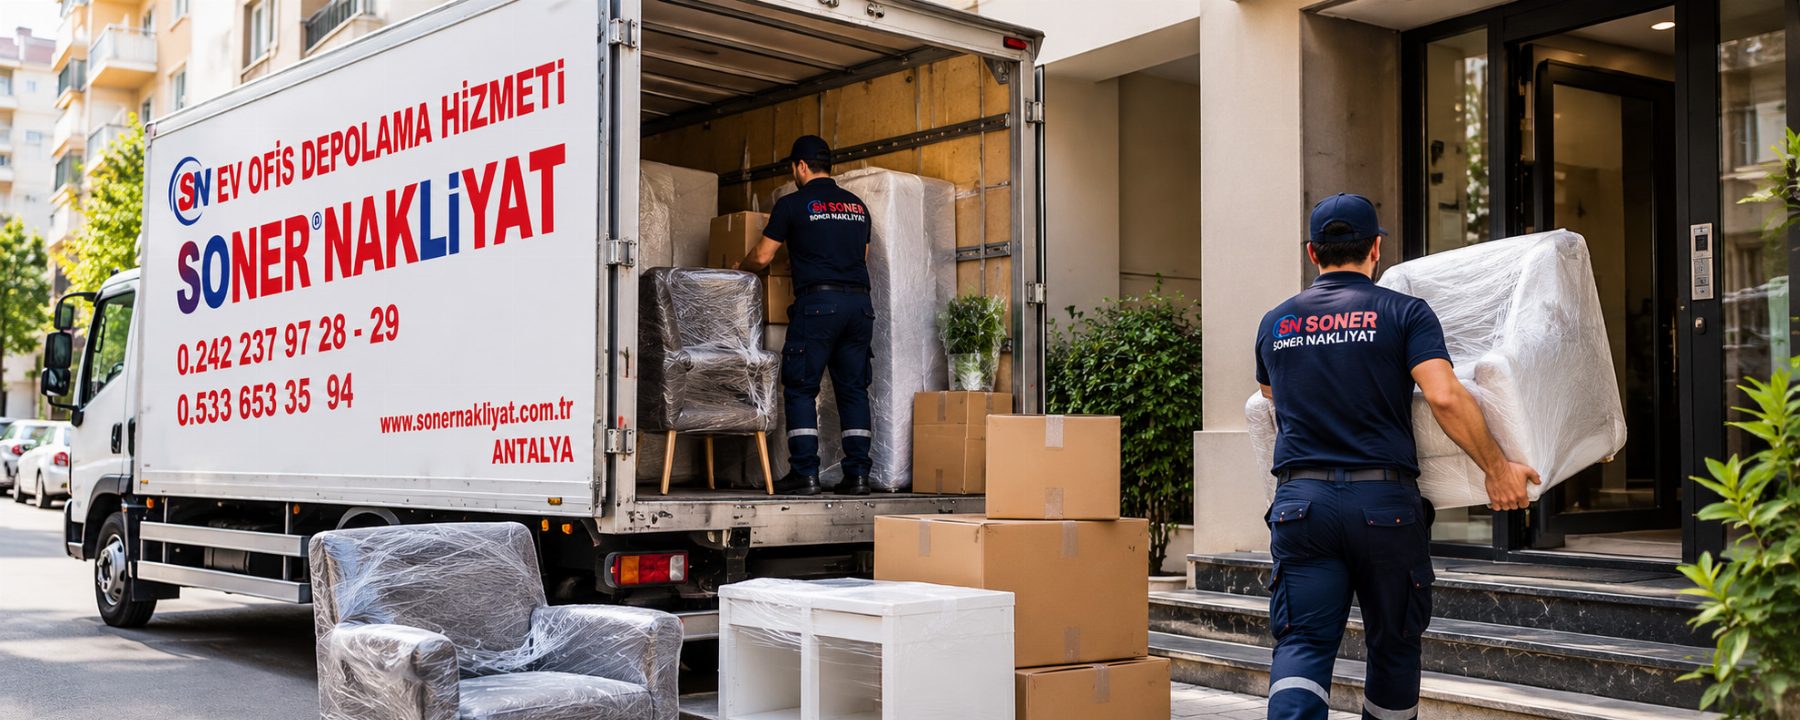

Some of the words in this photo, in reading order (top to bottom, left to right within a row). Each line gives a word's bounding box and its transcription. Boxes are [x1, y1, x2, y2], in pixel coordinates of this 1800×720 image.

[178, 168, 212, 212] SN
[217, 160, 243, 204] EV
[302, 102, 433, 181] DEPOLAMA
[828, 202, 865, 214] SONER
[177, 214, 311, 314] SONER
[177, 335, 233, 376] 0.242
[239, 326, 278, 367] 237
[285, 320, 312, 359] 97
[318, 313, 347, 353] 28
[369, 303, 400, 345] 29
[1305, 311, 1378, 333] SONER
[177, 389, 232, 427] 0.533
[239, 382, 278, 420] 653
[284, 377, 312, 415] 35
[326, 371, 354, 411] 94
[380, 396, 574, 434] www.sonernakliyat.com.tr
[491, 435, 575, 465] ANTALYA
